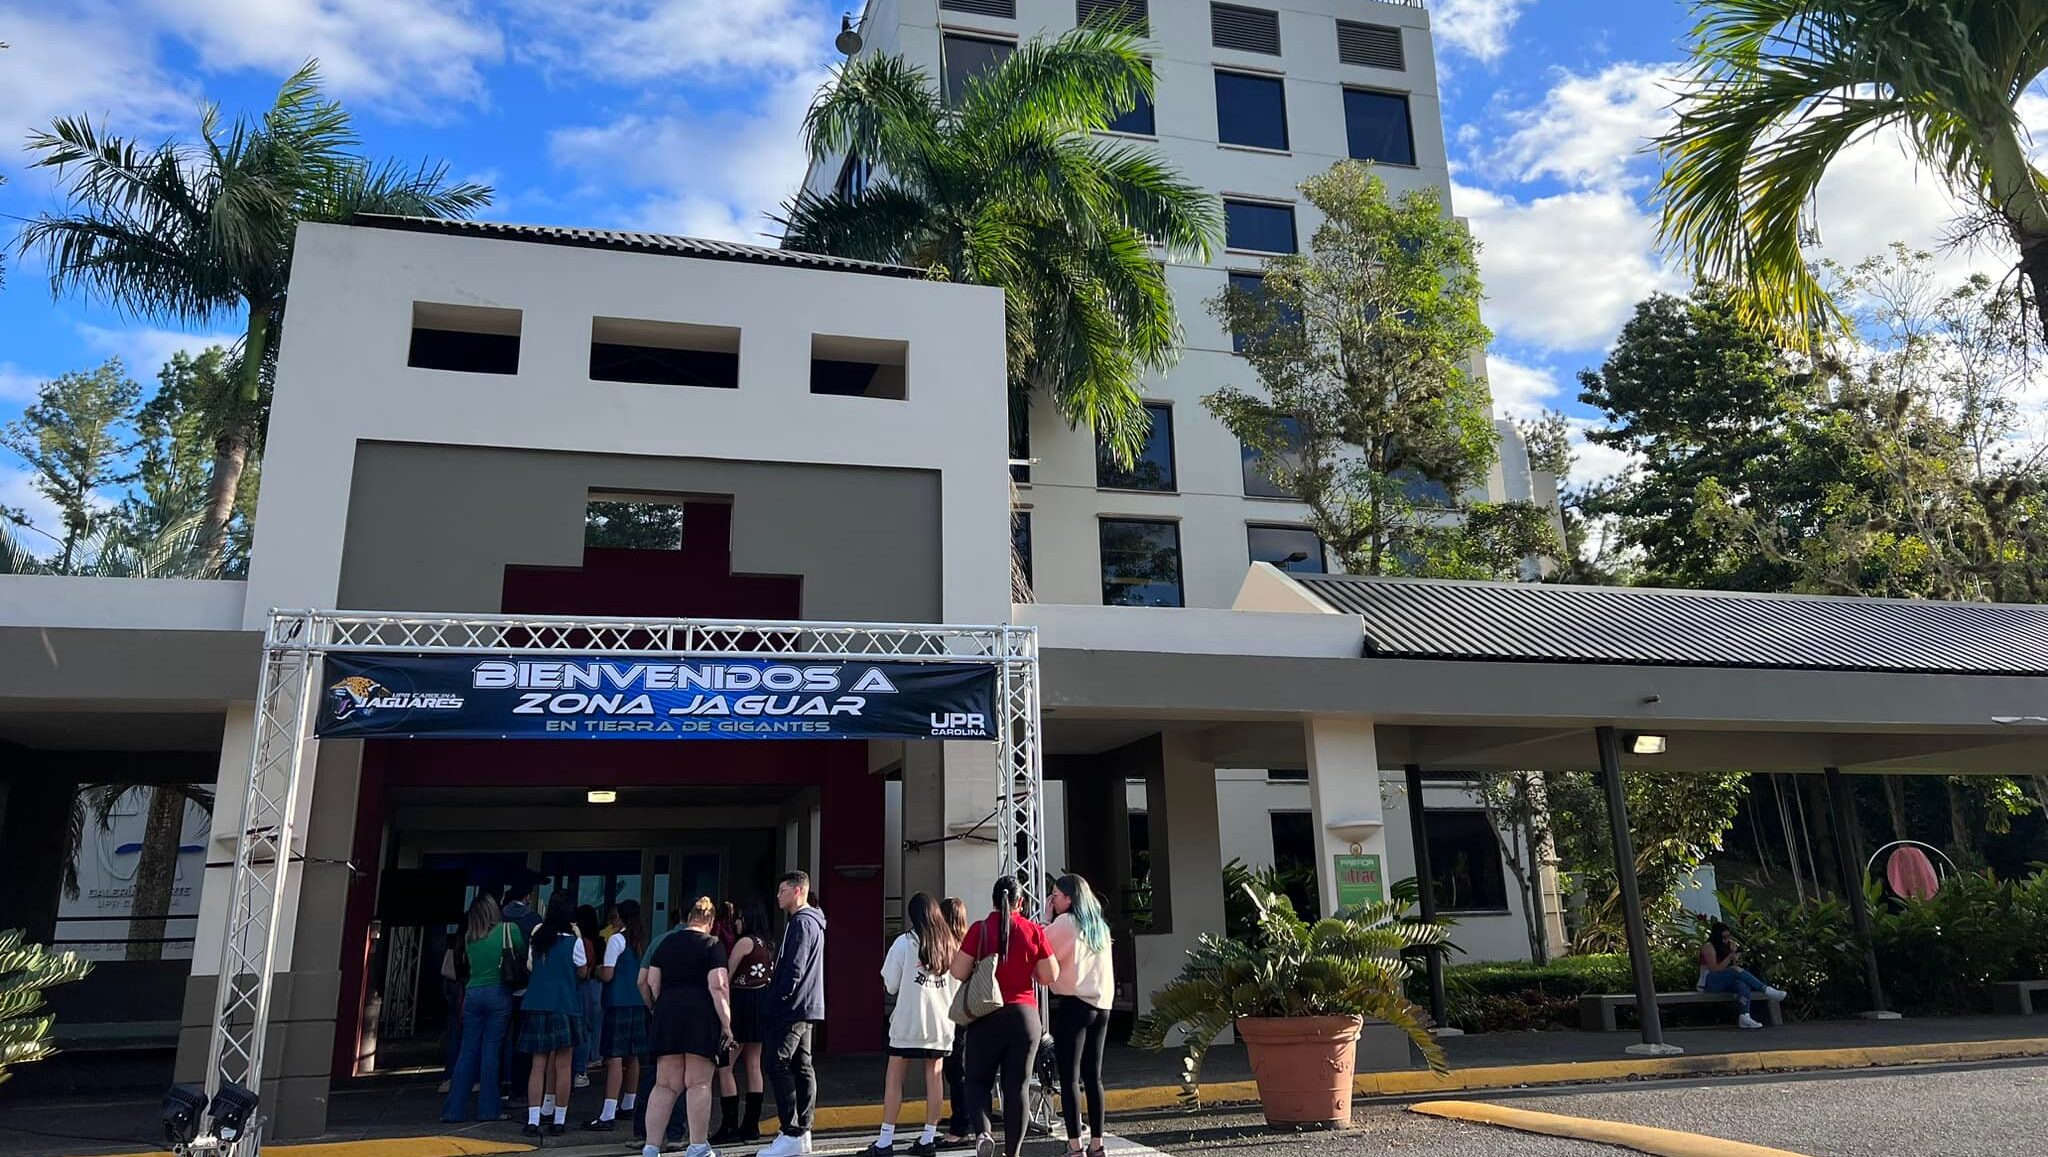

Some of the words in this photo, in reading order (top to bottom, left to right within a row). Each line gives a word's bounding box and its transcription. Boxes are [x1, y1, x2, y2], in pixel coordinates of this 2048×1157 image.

[472, 660, 842, 693] BIENVENIDOS
[848, 666, 899, 693] A
[355, 697, 465, 709] JAGUARES
[512, 693, 655, 715] ZONA
[669, 694, 867, 716] JAGUAR
[545, 720, 577, 732] EN
[583, 720, 675, 732] TIERRA
[681, 721, 711, 732] DE
[717, 721, 831, 733] GIGANTES
[930, 713, 986, 728] UPR
[930, 728, 987, 737] CAROLINA
